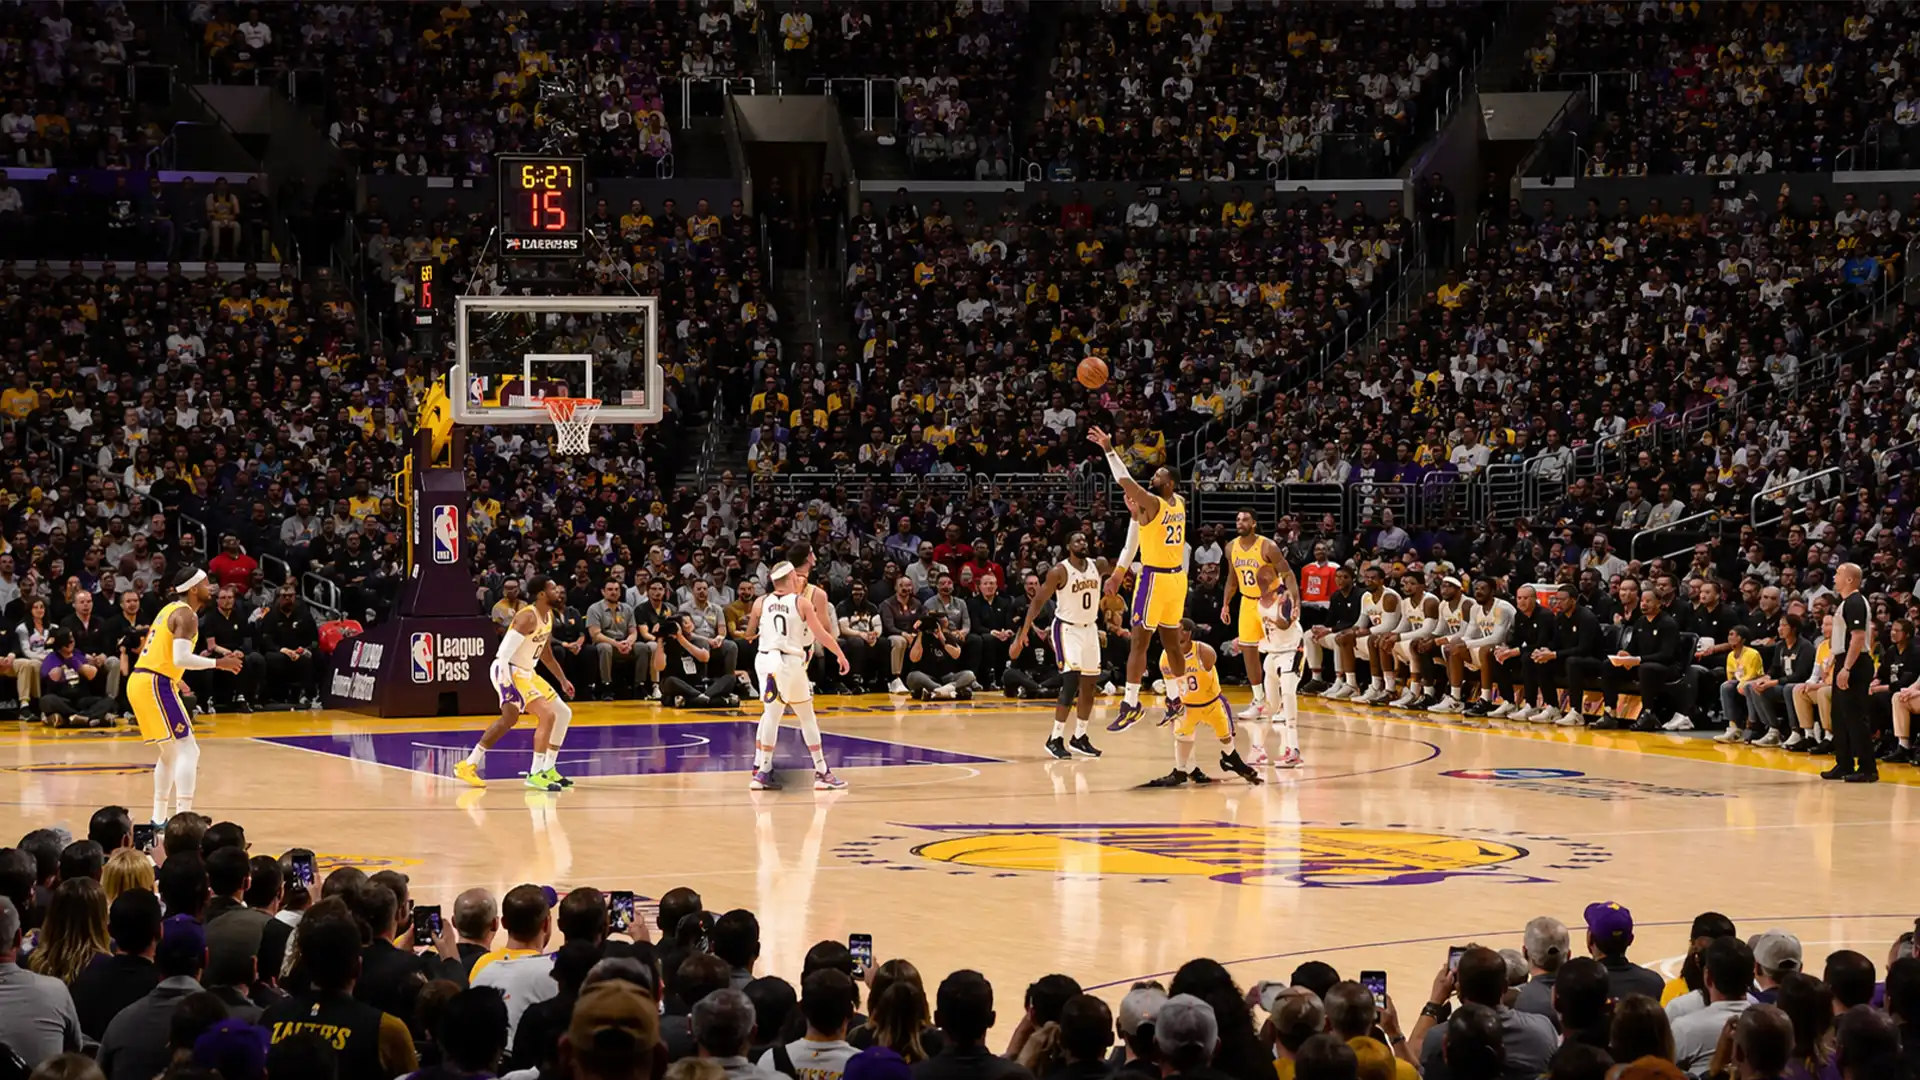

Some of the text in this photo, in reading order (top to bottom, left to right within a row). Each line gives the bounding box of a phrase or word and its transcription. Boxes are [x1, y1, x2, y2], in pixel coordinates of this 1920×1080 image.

[522, 165, 572, 189] 6:27
[532, 191, 566, 230] 15
[1165, 525, 1182, 545] 23
[1241, 570, 1256, 586] 13
[1083, 592, 1091, 610] 0
[773, 614, 787, 637] 0
[436, 633, 485, 660] League
[436, 659, 470, 682] Pass
